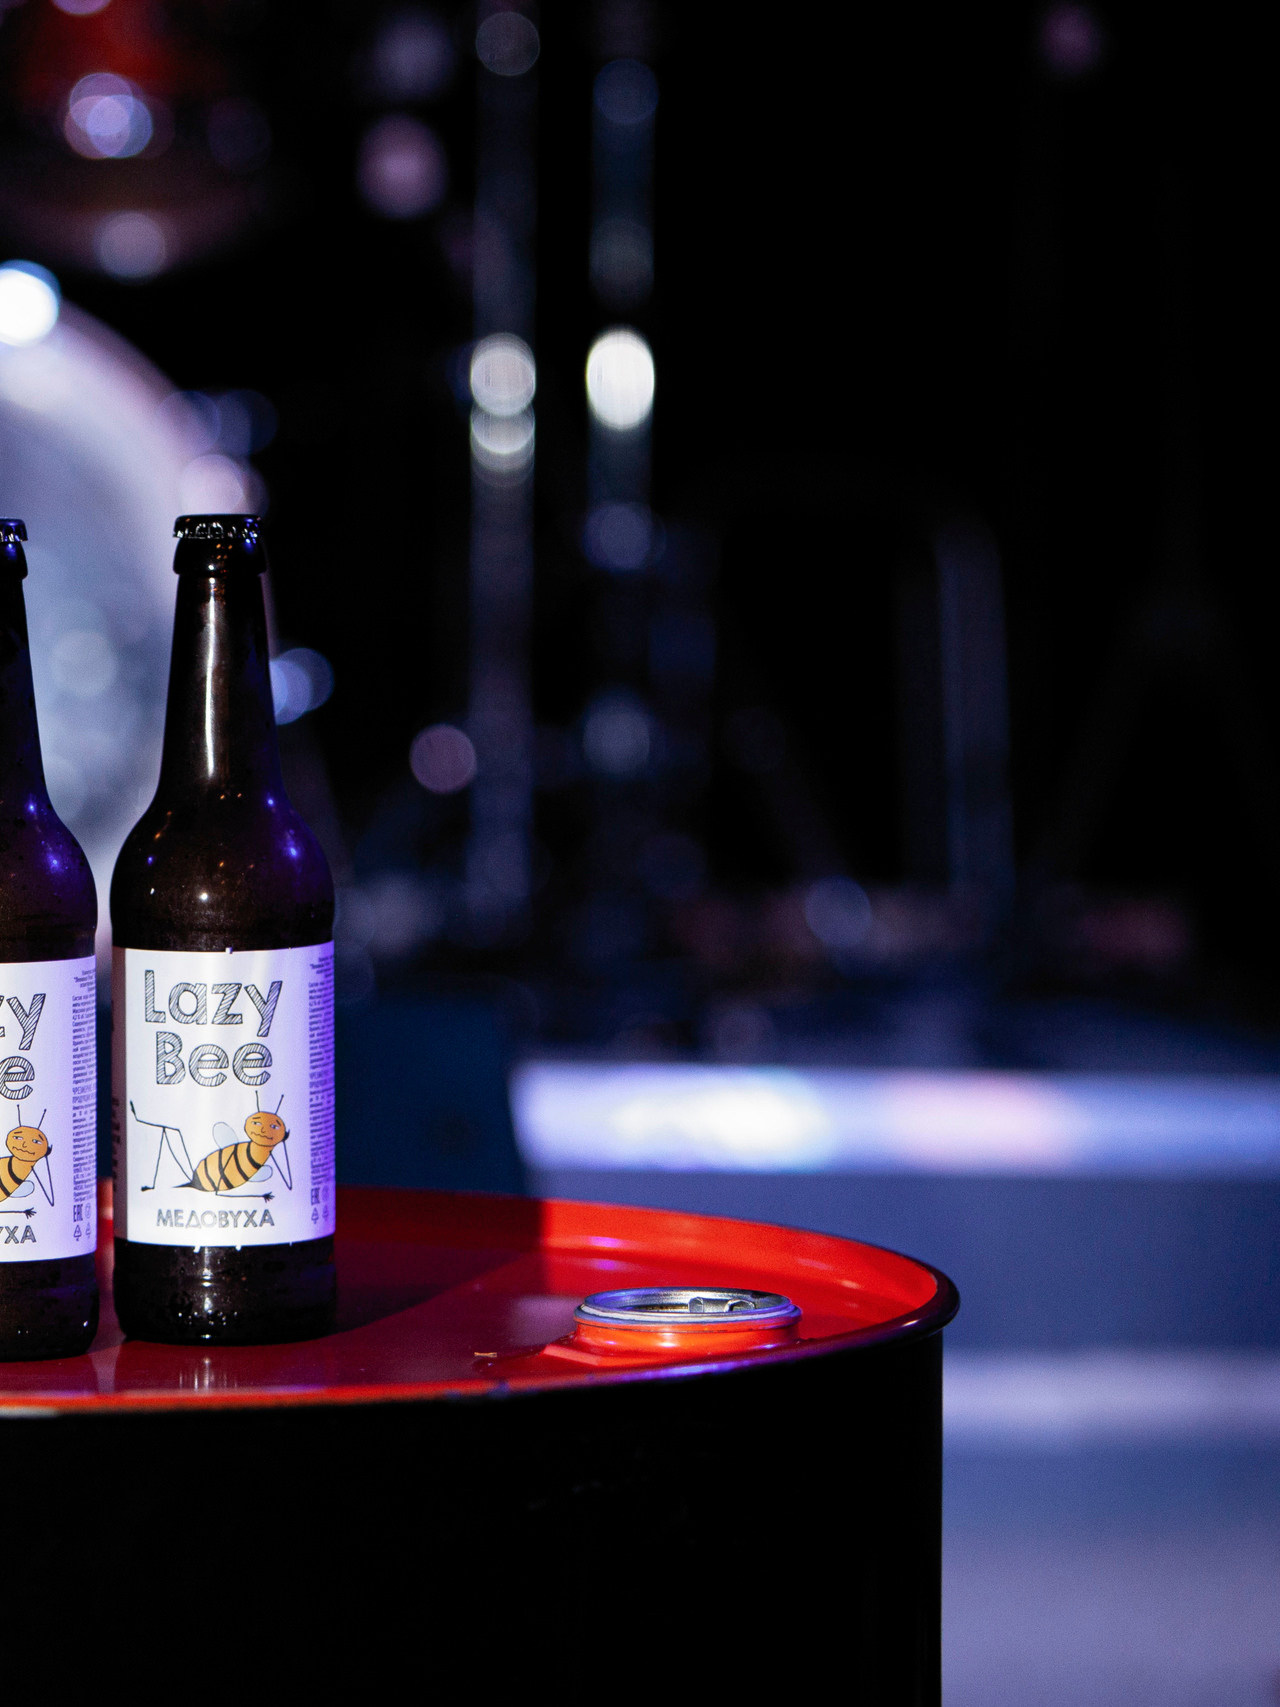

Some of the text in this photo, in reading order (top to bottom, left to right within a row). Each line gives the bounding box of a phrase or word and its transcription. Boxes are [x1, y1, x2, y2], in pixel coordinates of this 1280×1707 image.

[144, 969, 283, 1037] Lazy
[155, 1030, 273, 1087] Bee
[156, 1208, 275, 1229] МЕДОВУХА
